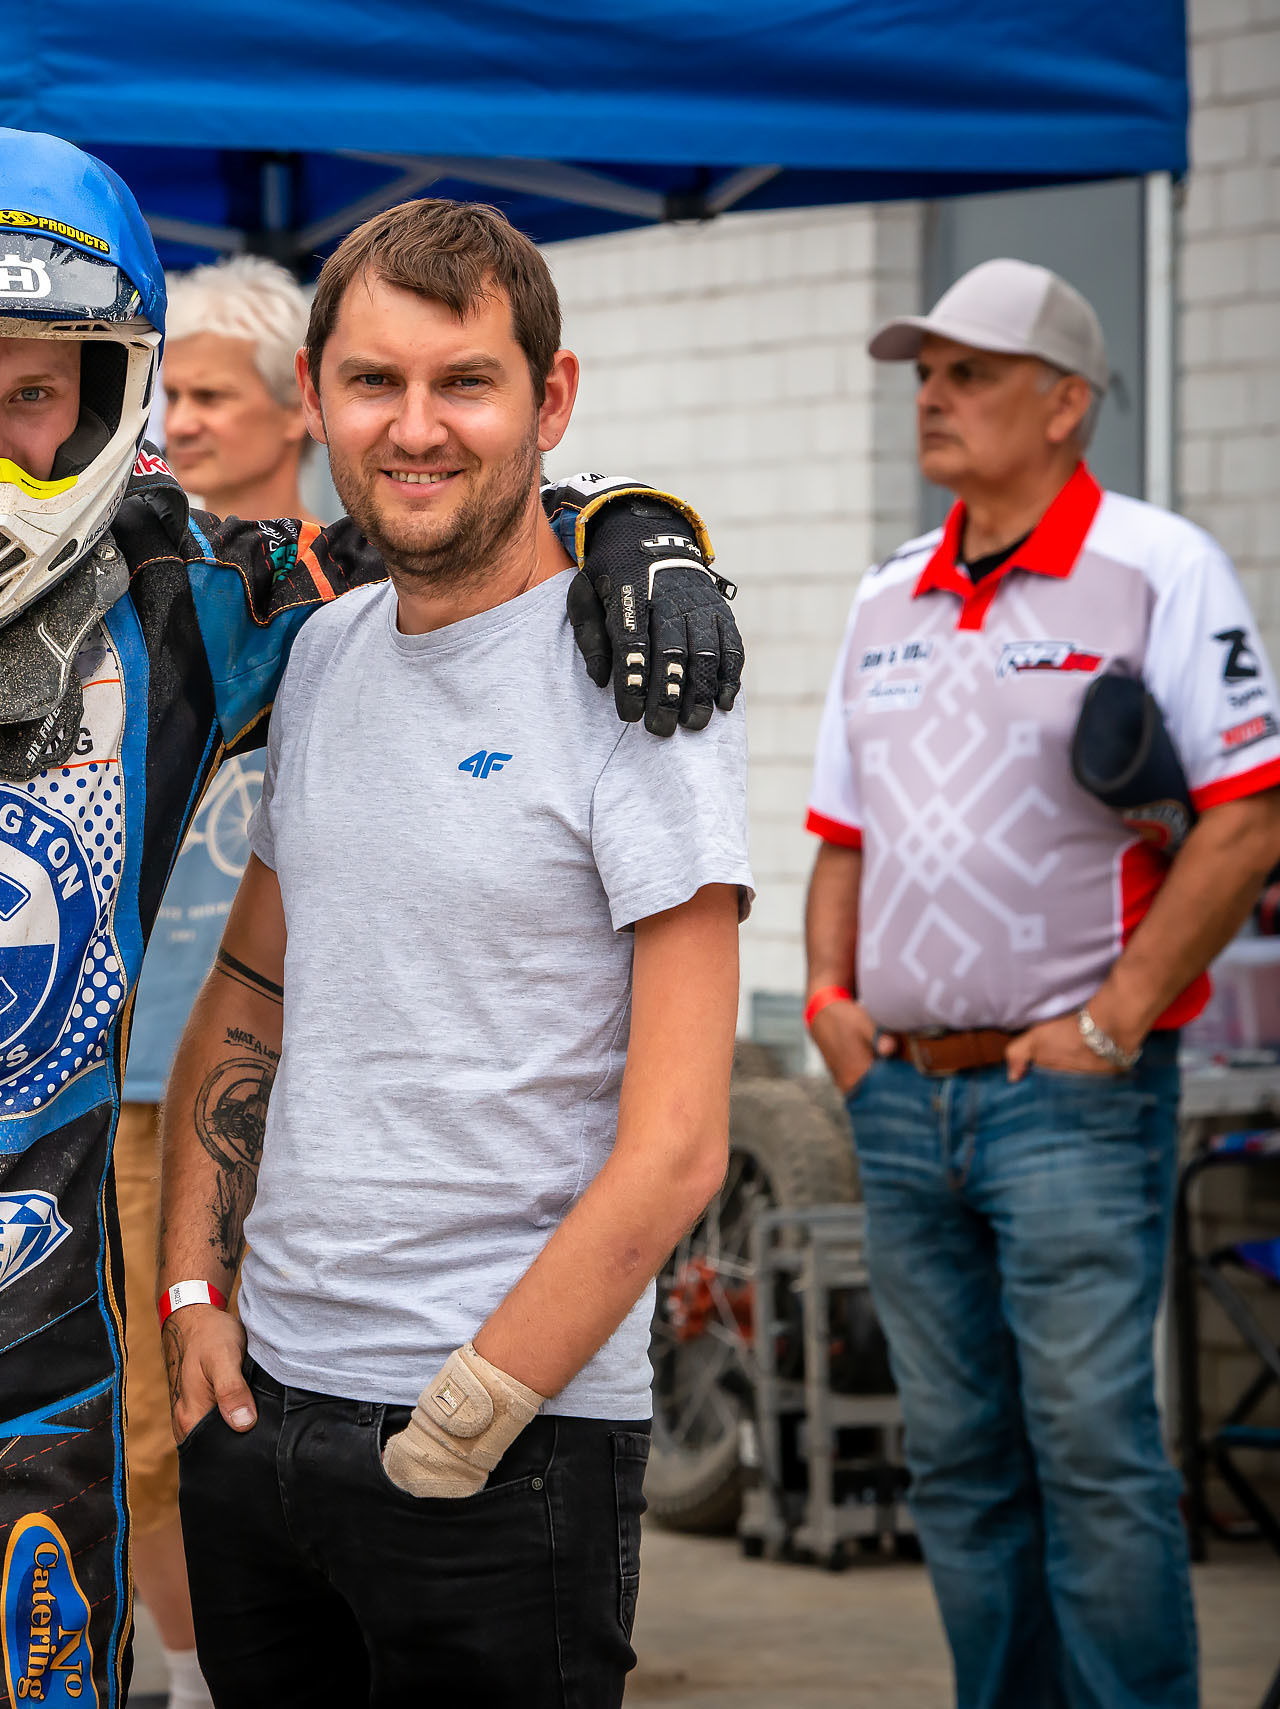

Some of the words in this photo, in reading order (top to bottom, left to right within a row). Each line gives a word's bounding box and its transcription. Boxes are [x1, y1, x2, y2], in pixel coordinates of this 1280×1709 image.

[38, 217, 110, 252] PRODUCTS
[458, 750, 513, 779] 4F
[17, 1541, 59, 1701] Catering
[49, 1624, 86, 1699] No
